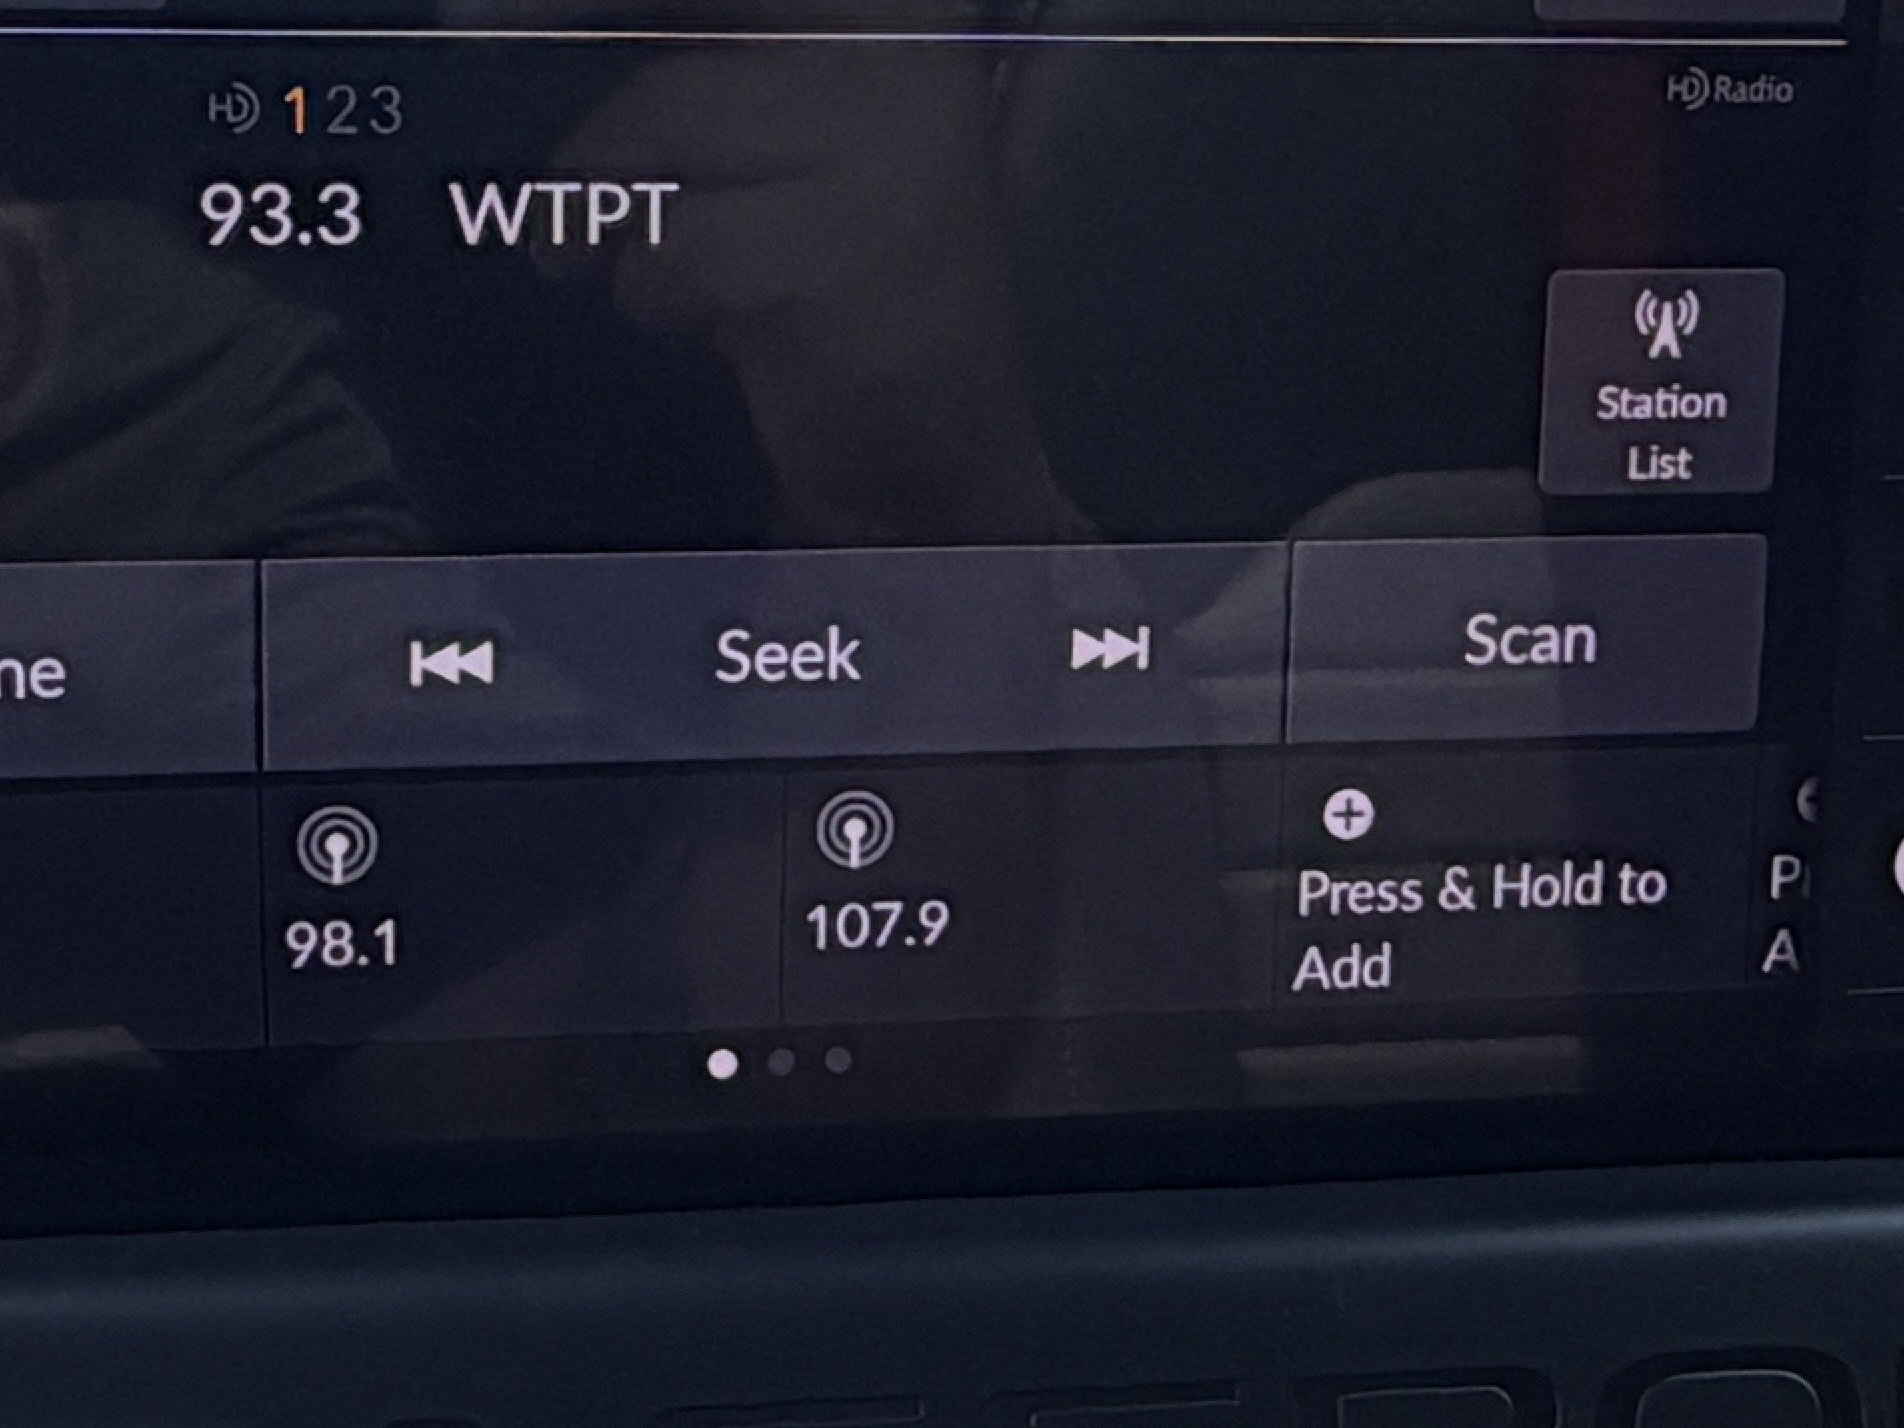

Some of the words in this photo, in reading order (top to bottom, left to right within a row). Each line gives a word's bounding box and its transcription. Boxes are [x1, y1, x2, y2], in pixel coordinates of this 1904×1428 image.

[1715, 74, 1794, 103] Radio
[200, 182, 362, 246] 93.3
[448, 182, 680, 246] WTPT
[1596, 382, 1727, 420] Station
[1628, 444, 1694, 480] List
[715, 624, 861, 683] Seek
[1464, 612, 1596, 666] Scan
[1298, 870, 1424, 916] Press
[1438, 865, 1476, 912] &
[1493, 860, 1604, 909] Hold
[1618, 862, 1668, 905] to
[286, 918, 395, 969] 98.1
[806, 900, 950, 950] 107.9
[1292, 941, 1392, 992] Add
